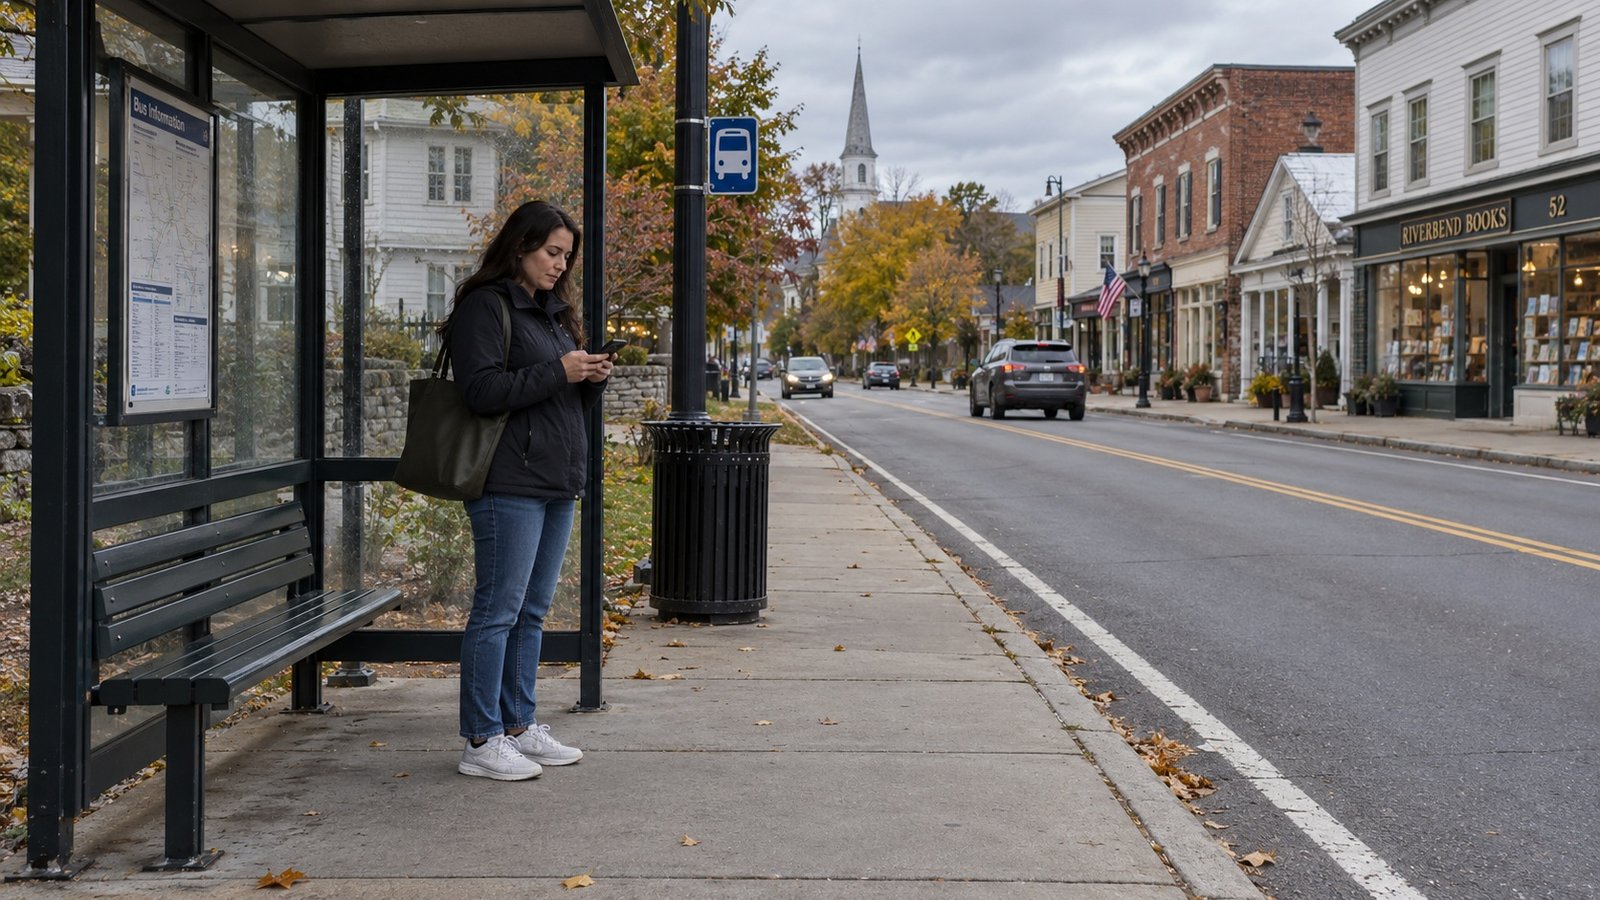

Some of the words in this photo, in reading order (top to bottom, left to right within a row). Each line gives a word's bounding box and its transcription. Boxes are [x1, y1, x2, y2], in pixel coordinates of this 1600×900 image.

[133, 96, 147, 115] Bus
[149, 103, 185, 132] Information
[1549, 194, 1566, 218] 52
[1402, 216, 1461, 245] RIVERBEND
[1466, 207, 1507, 233] BOOKS
